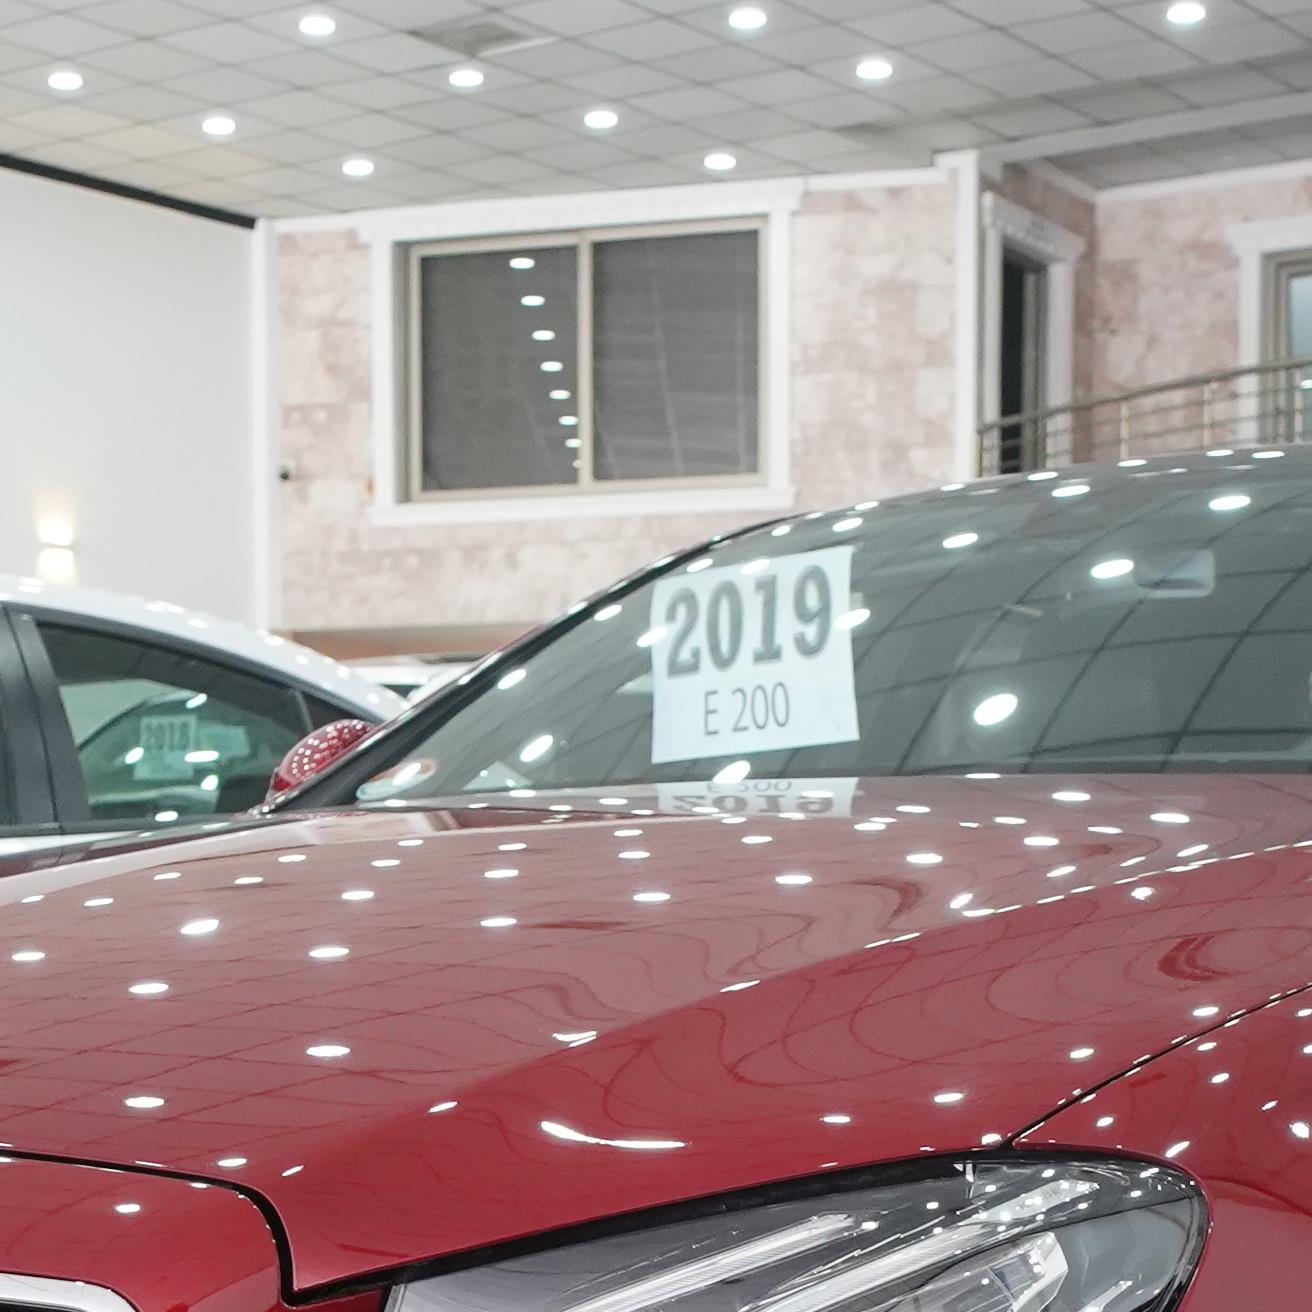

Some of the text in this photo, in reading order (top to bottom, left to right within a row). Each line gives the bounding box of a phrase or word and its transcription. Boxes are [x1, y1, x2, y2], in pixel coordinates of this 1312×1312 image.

[665, 564, 831, 679] 2019
[704, 682, 790, 735] E 200
